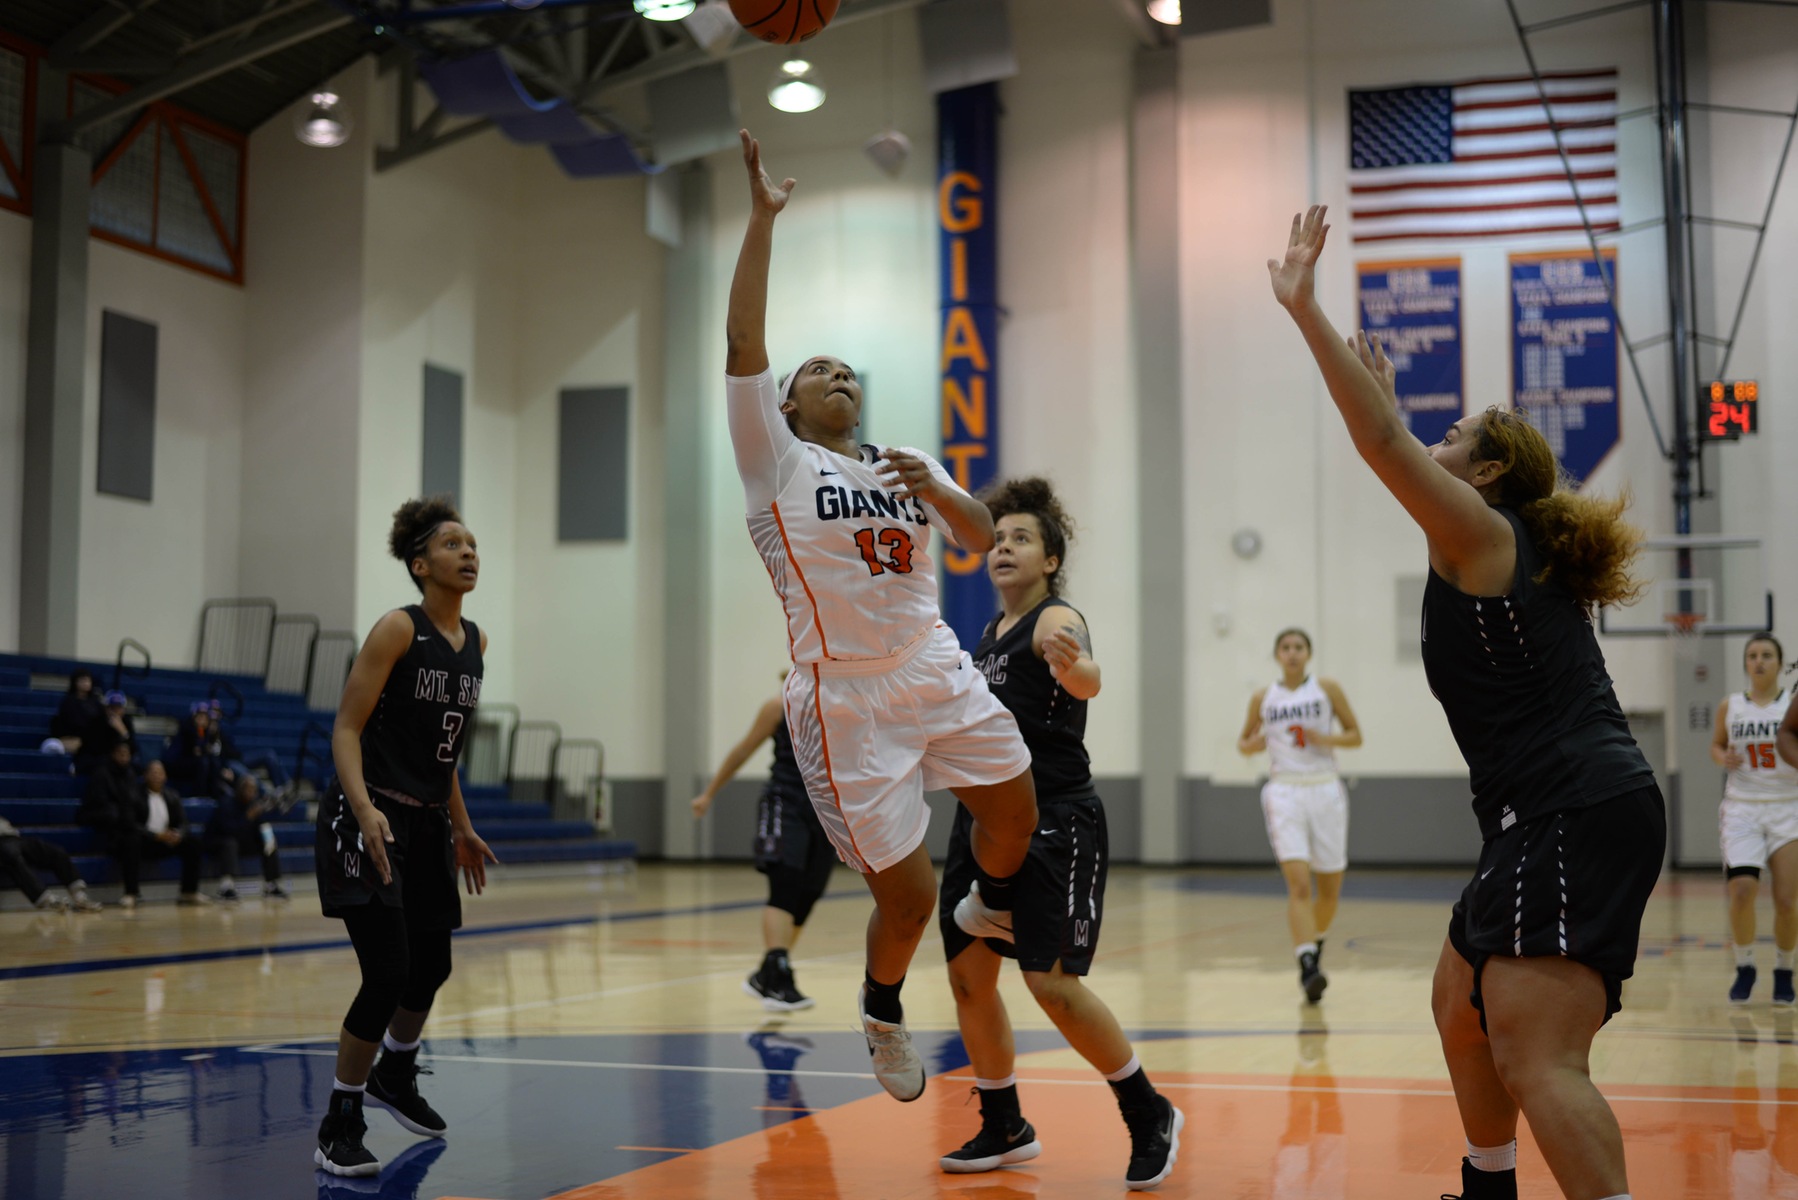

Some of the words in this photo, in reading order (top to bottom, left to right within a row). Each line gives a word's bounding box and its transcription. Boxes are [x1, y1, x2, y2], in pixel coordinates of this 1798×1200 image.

[1709, 402, 1750, 436] 24
[816, 485, 929, 526] GIANTS
[854, 527, 914, 577] 13
[973, 654, 1008, 684] AC
[415, 667, 450, 703] MT.
[458, 674, 483, 708] SA
[1266, 700, 1321, 724] GIANTS
[437, 711, 463, 762] 3
[1731, 721, 1780, 738] GIANT
[1746, 742, 1776, 769] 15
[344, 851, 360, 878] M
[1074, 918, 1089, 947] M
